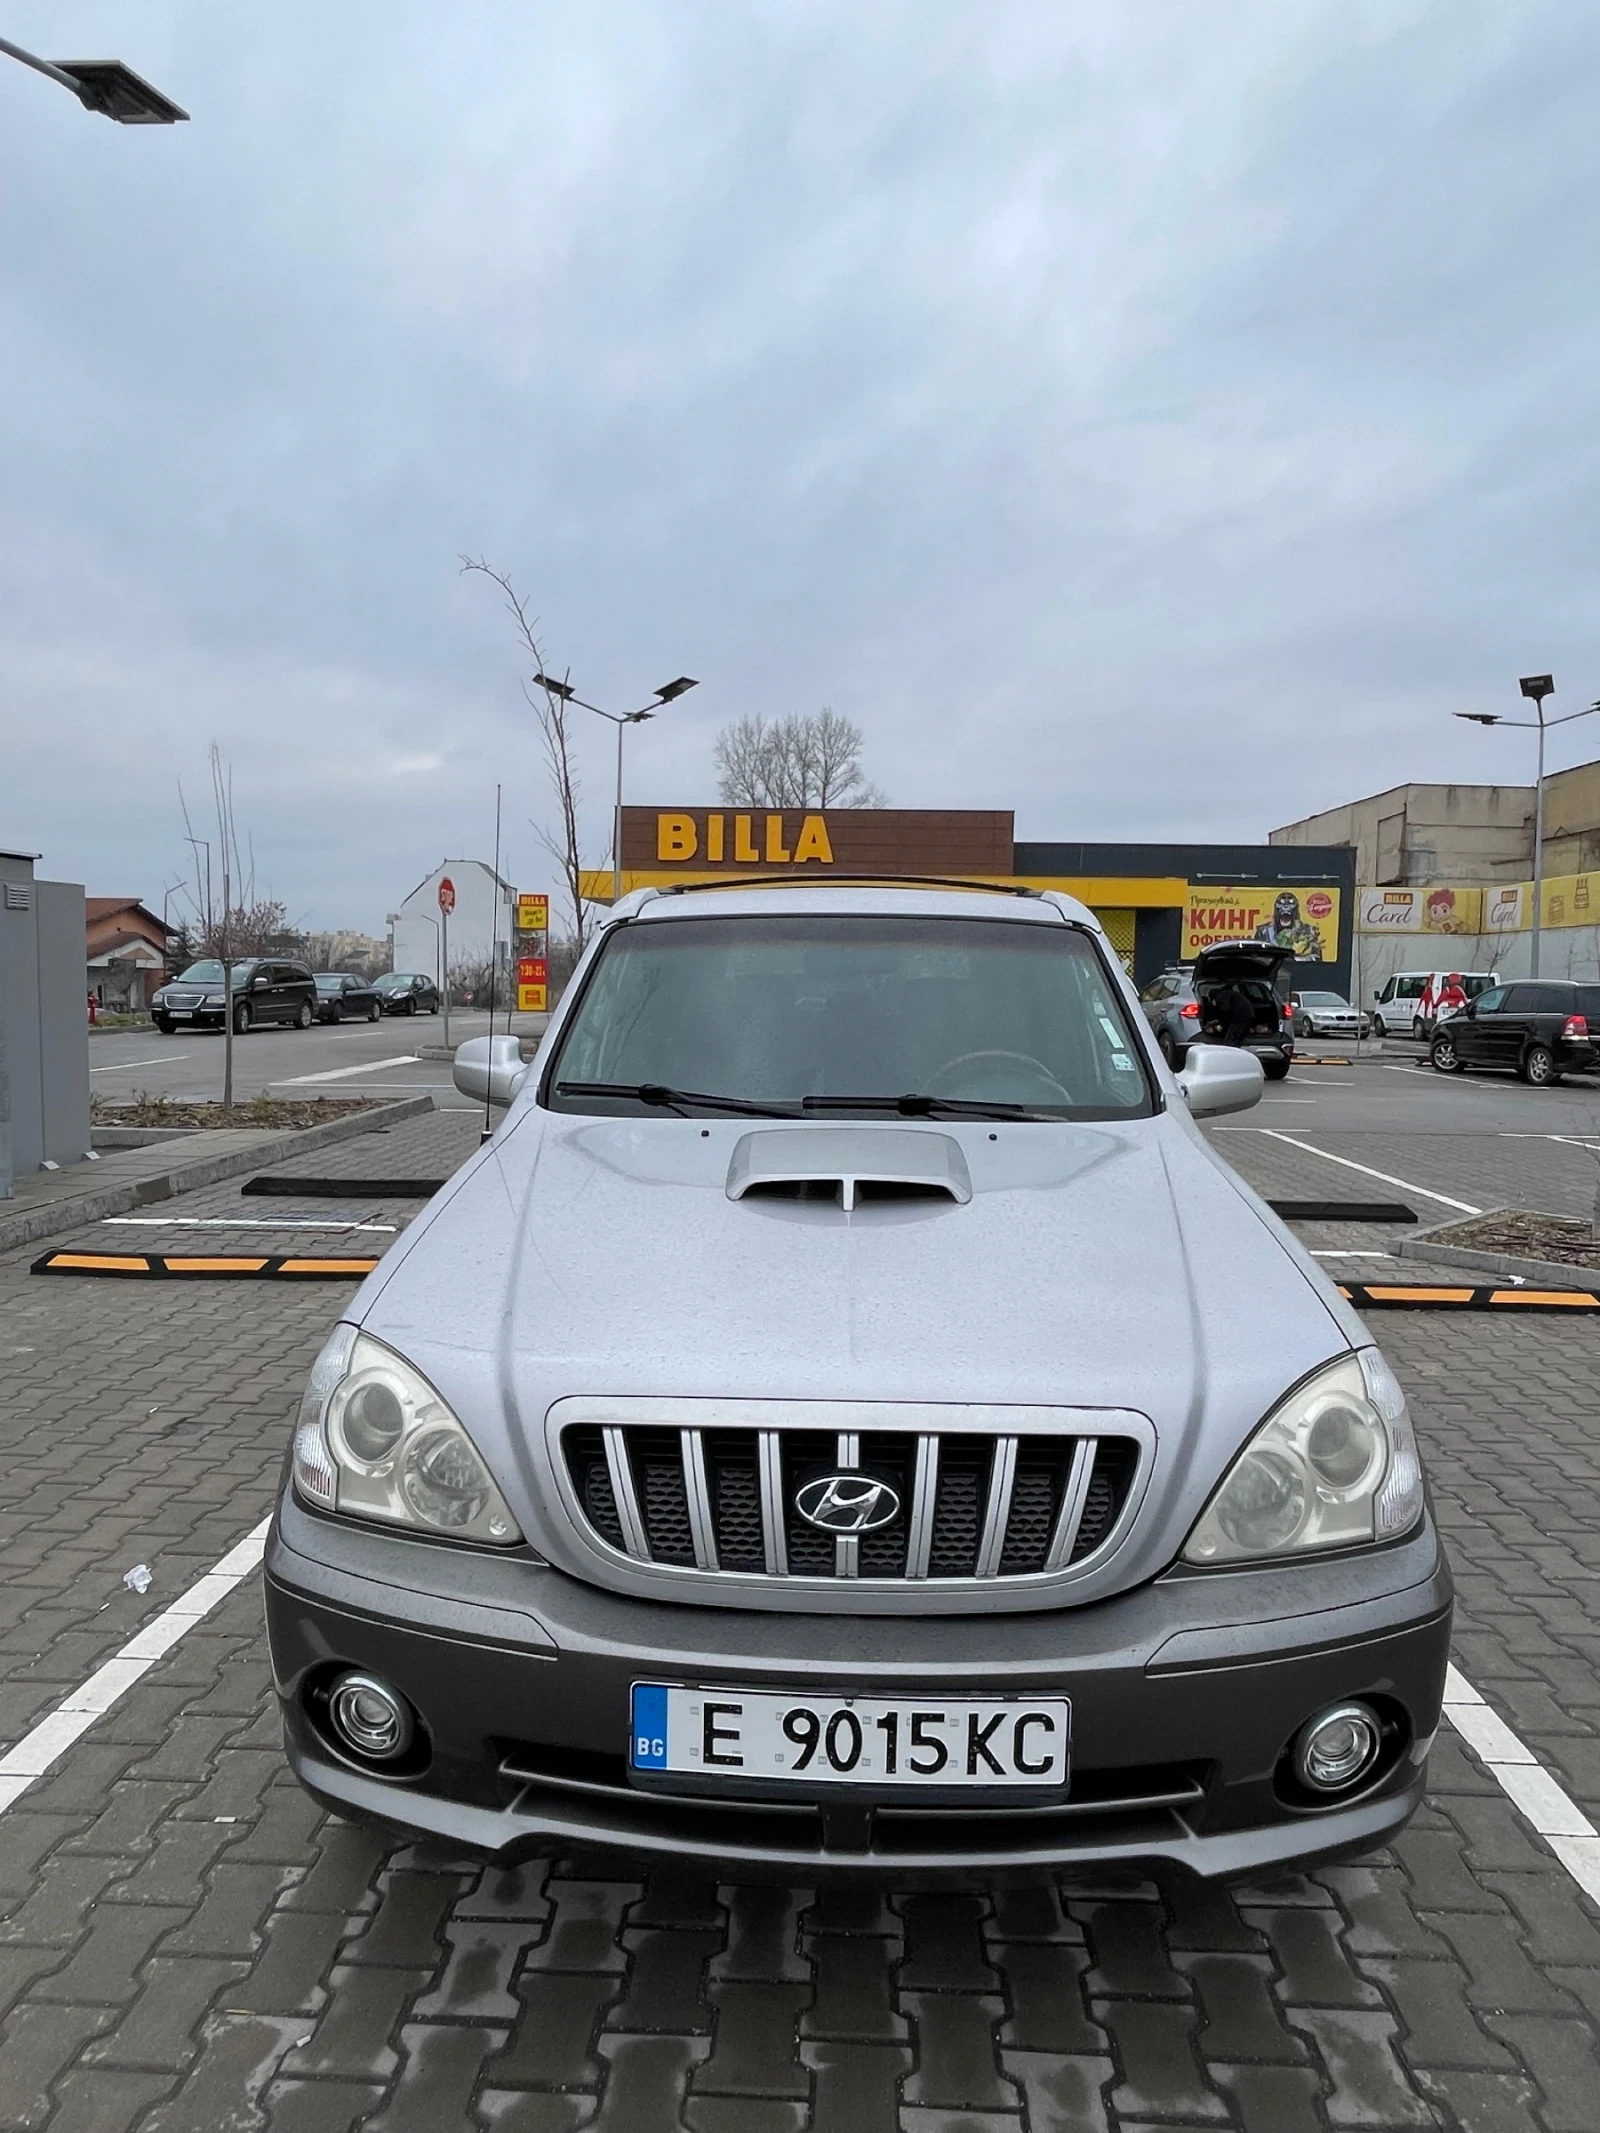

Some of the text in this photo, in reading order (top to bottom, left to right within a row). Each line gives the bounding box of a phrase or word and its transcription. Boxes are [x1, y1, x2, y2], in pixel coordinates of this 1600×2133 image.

[658, 814, 834, 864] BILLA
[521, 896, 545, 905] BILLA
[1386, 894, 1412, 904] BILLA
[1190, 908, 1260, 930] КИНГ
[1367, 904, 1413, 924] Card
[703, 1702, 744, 1766] E
[637, 1737, 664, 1757] BG
